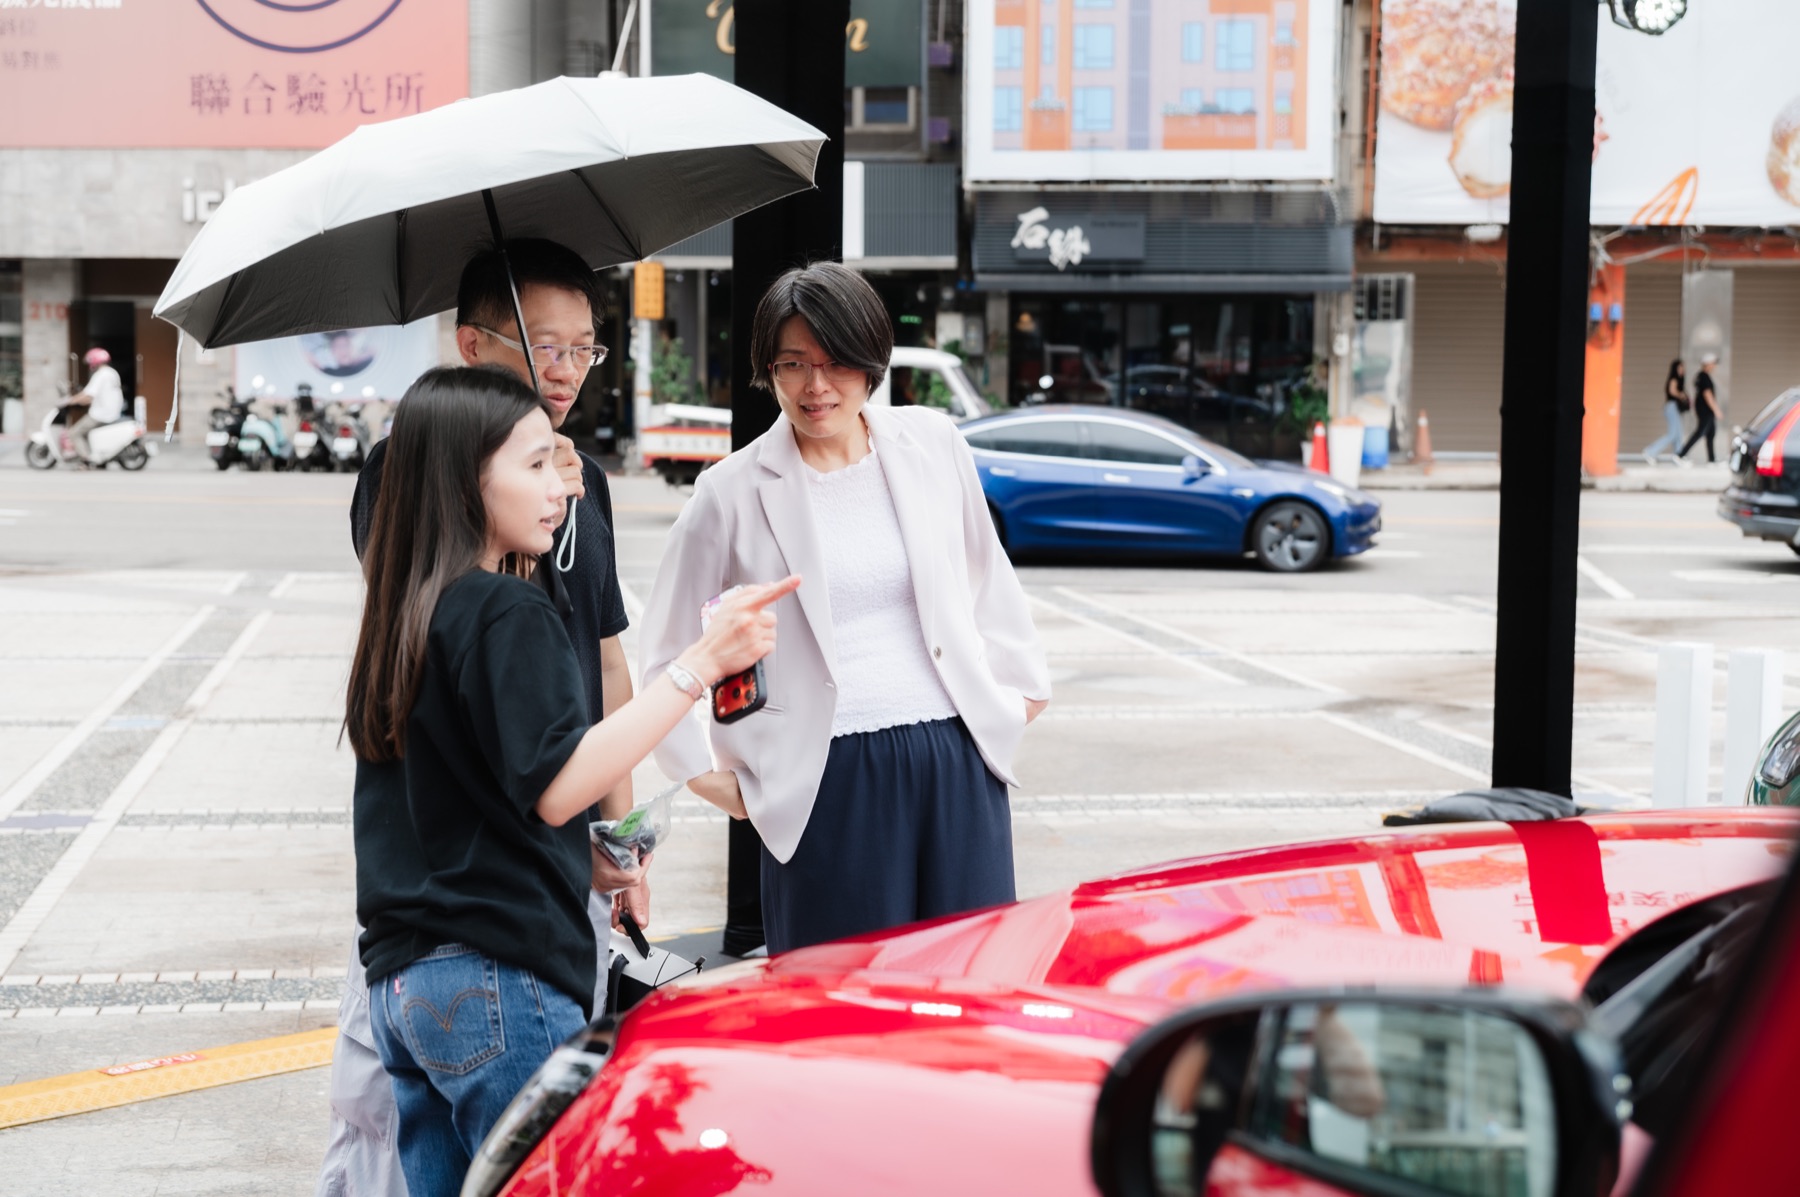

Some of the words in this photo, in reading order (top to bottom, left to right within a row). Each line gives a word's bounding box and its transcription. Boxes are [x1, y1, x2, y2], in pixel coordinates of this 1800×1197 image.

[190, 72, 424, 115] 聯合驗光所
[31, 302, 68, 320] 210
